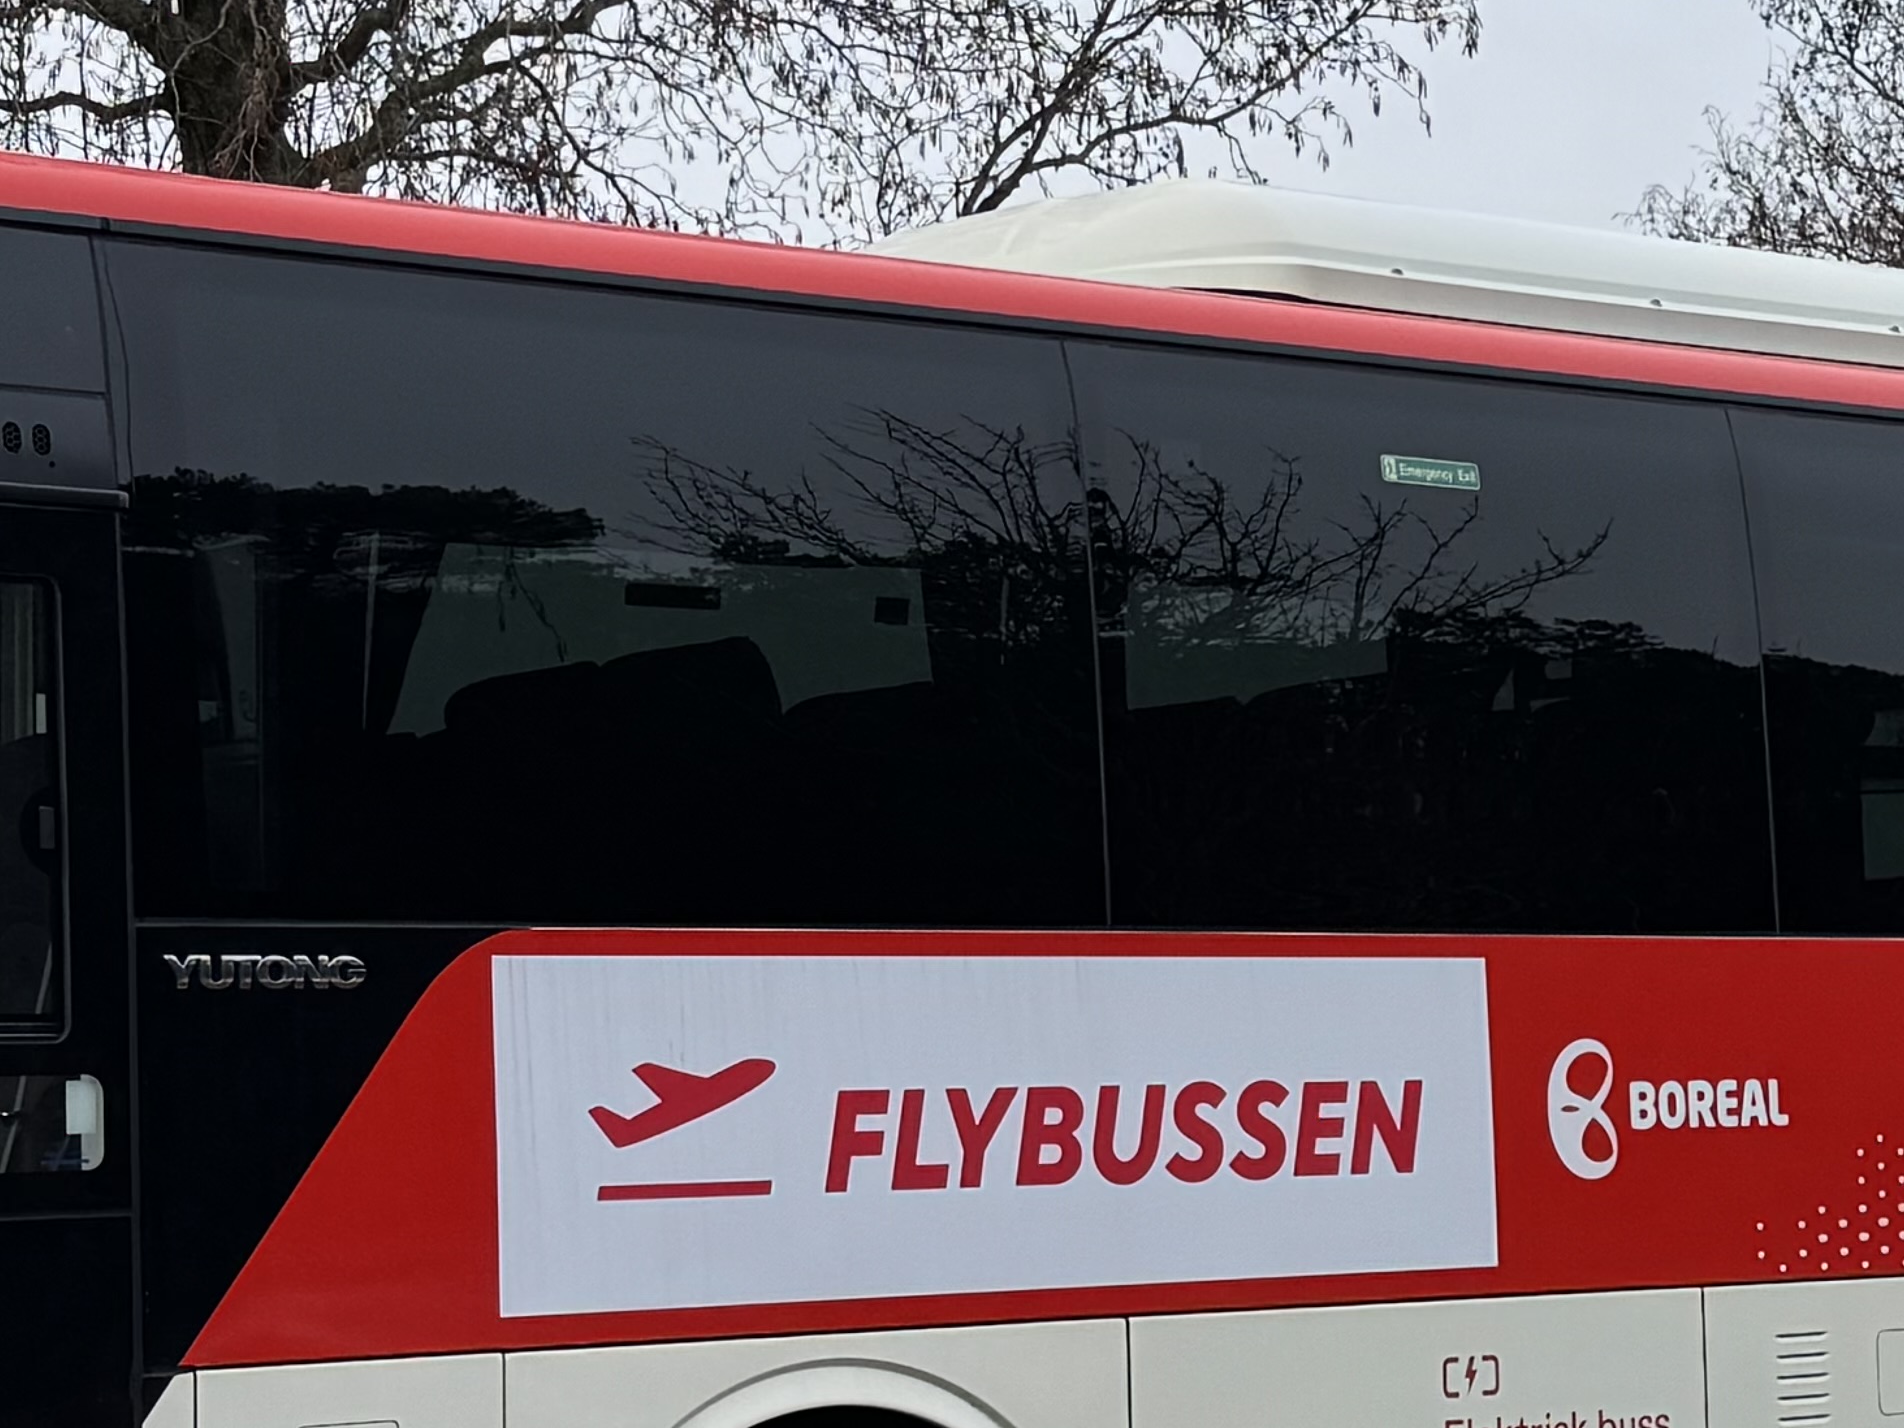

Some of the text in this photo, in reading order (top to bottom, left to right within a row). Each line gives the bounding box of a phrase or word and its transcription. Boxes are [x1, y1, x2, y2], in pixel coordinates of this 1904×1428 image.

[163, 954, 367, 989] YUTONG
[1630, 1078, 1789, 1130] BOREAL
[826, 1080, 1422, 1193] FLYBUSSEN
